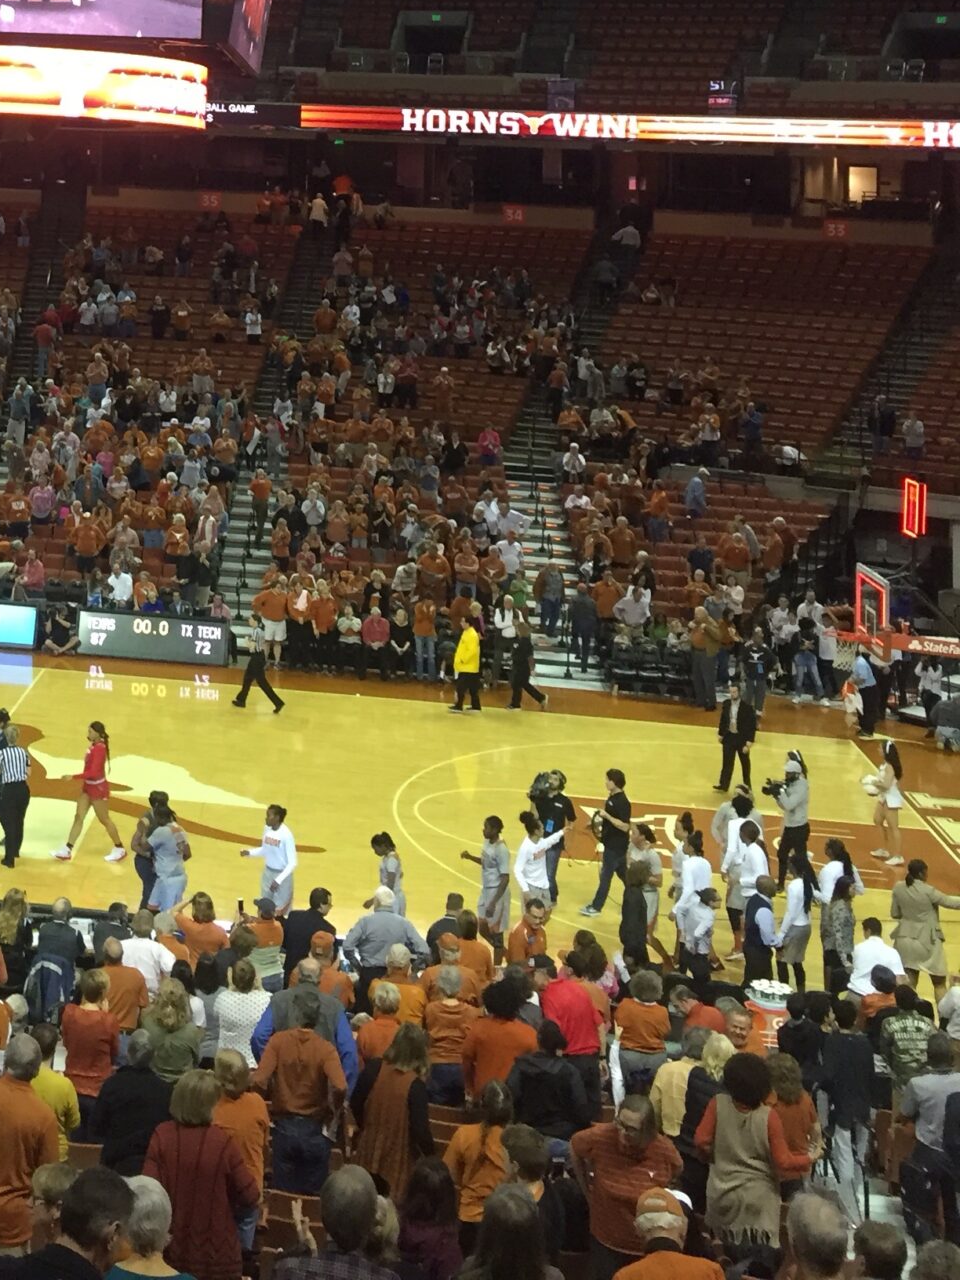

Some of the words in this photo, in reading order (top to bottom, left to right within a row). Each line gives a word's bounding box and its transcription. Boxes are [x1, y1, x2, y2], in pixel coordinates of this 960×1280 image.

[228, 104, 258, 114] GAME.
[401, 108, 521, 136] HORNS
[550, 113, 638, 139] WIN!
[827, 223, 845, 236] 33
[133, 618, 169, 636] 00.0
[181, 624, 193, 637] TX
[197, 625, 222, 640] TECH
[90, 632, 107, 646] 87
[195, 640, 212, 655] 72
